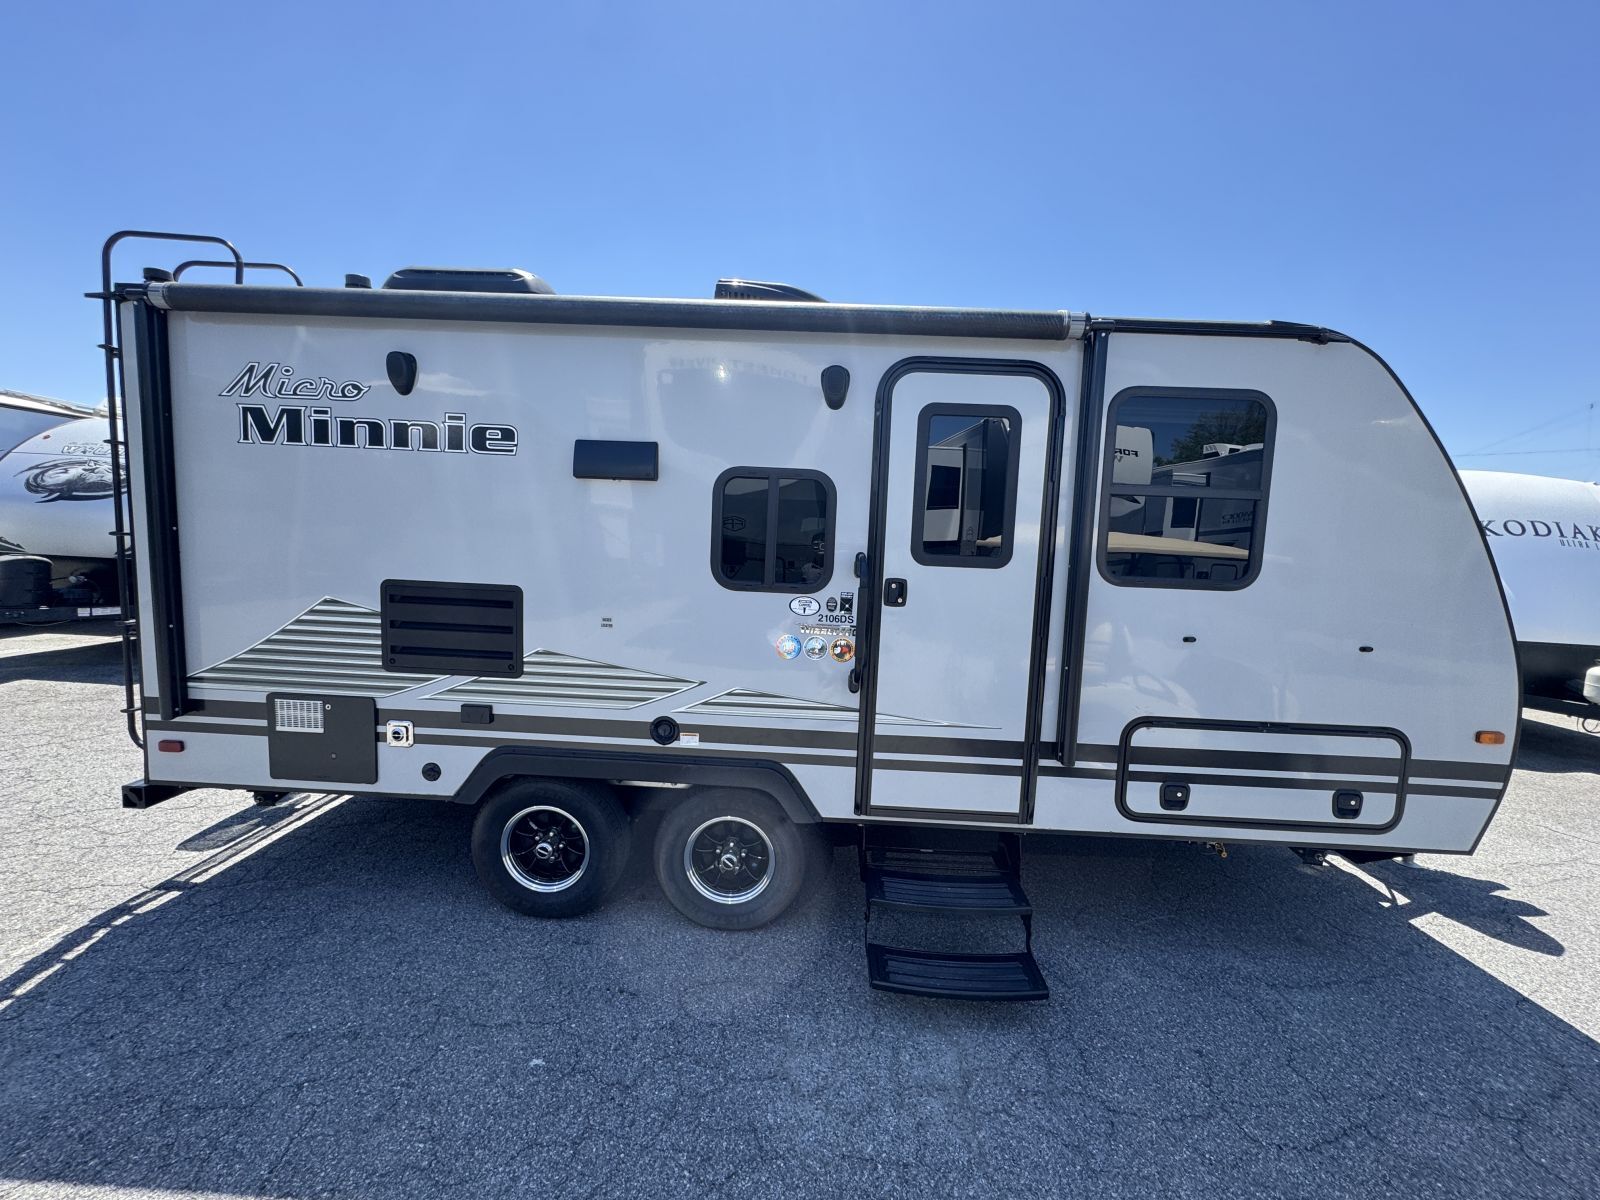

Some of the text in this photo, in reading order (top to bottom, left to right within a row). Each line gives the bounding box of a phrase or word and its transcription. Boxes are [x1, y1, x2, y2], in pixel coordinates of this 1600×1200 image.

[219, 361, 371, 401] Micro
[236, 403, 518, 456] Minnie
[1480, 519, 1600, 542] KODIAK
[818, 614, 854, 624] 2106DS
